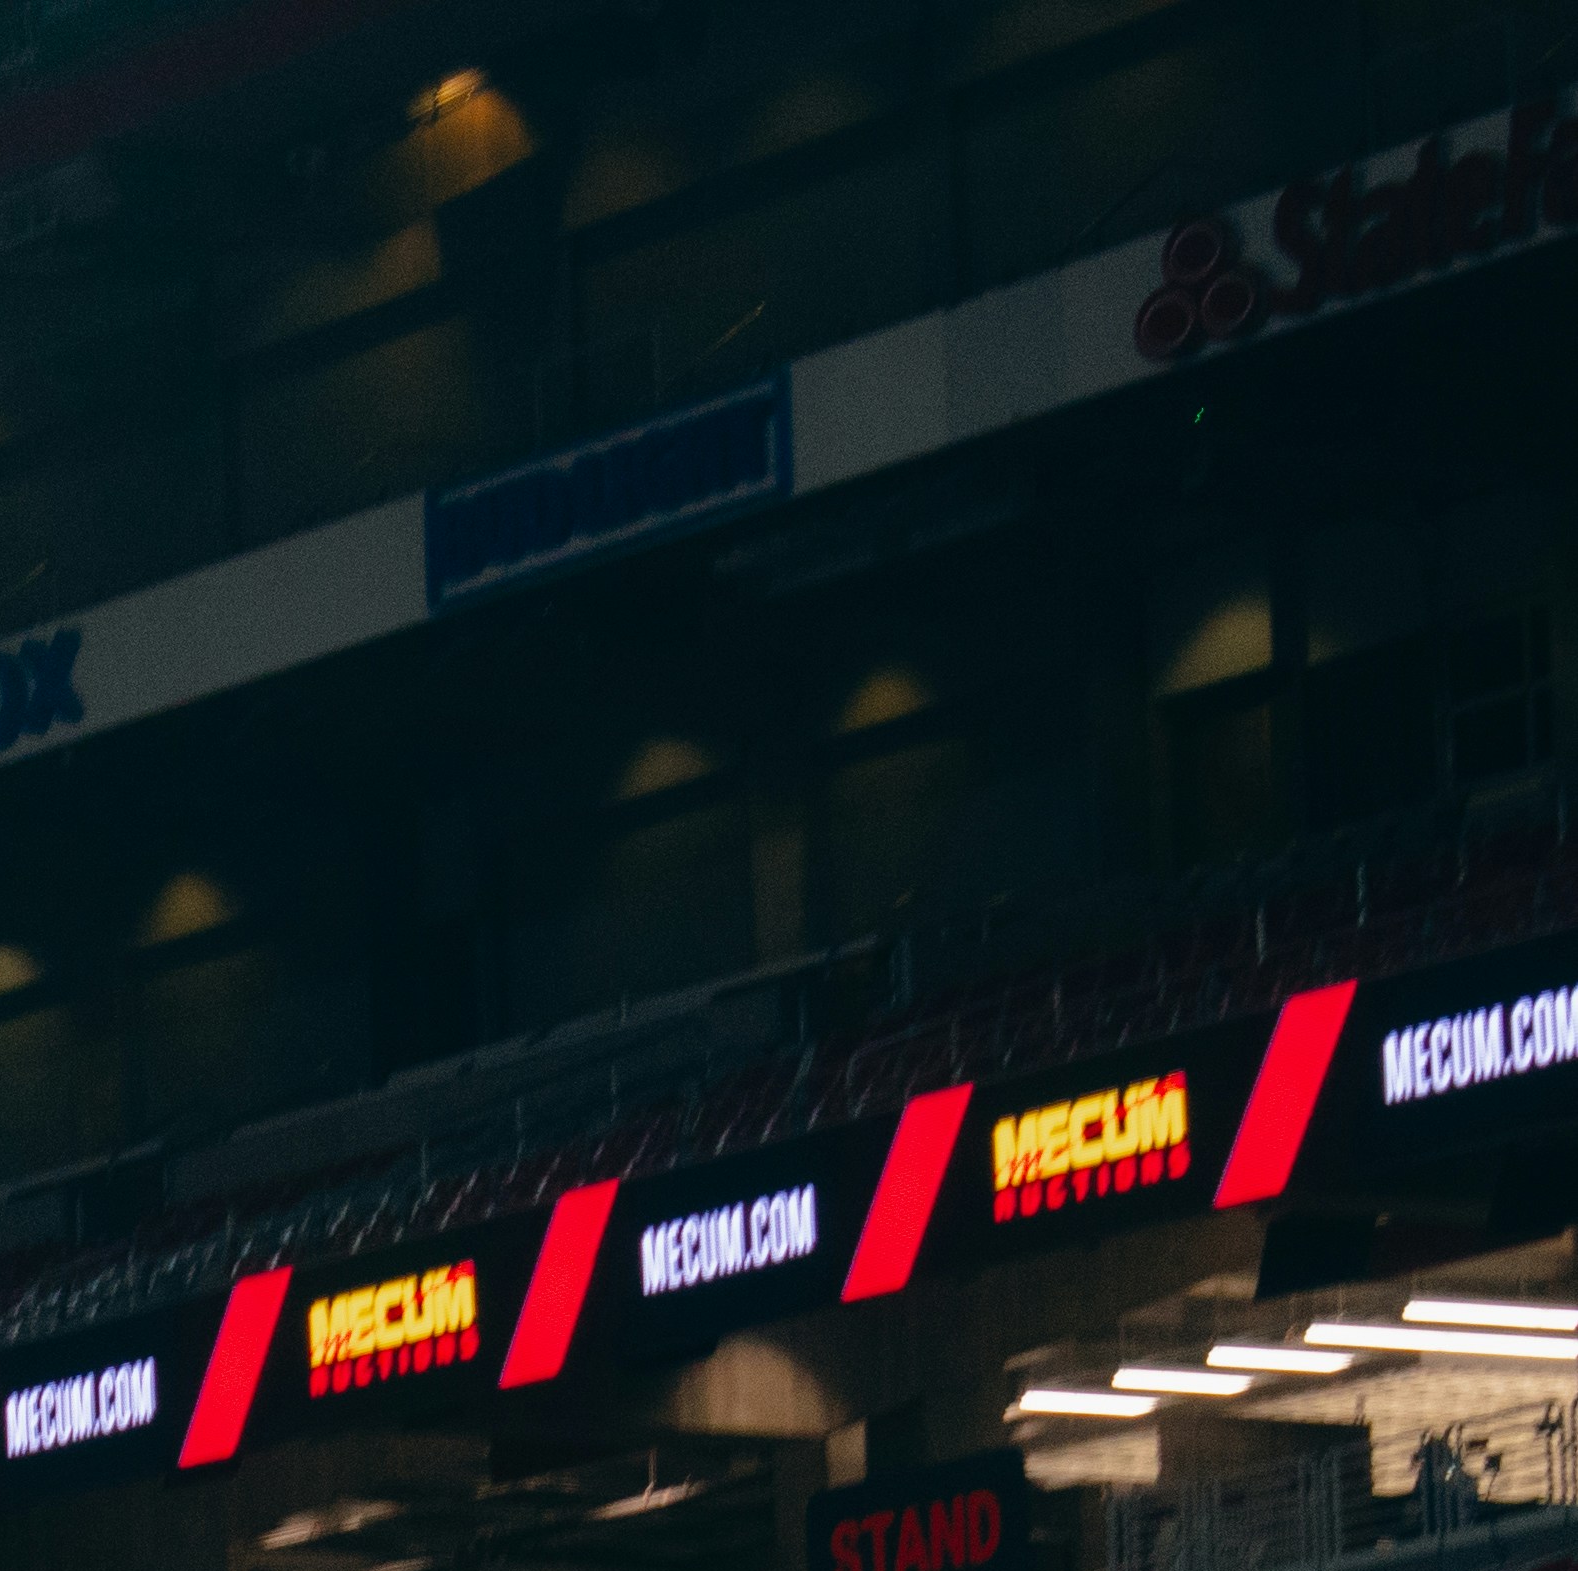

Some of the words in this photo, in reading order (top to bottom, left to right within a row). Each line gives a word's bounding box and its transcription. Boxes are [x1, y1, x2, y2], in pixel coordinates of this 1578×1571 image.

[992, 1073, 1188, 1191] MECUM
[641, 1183, 817, 1296] MECUM.COM
[308, 1261, 477, 1368] MECUM
[5, 1356, 157, 1458] MECUM.COM
